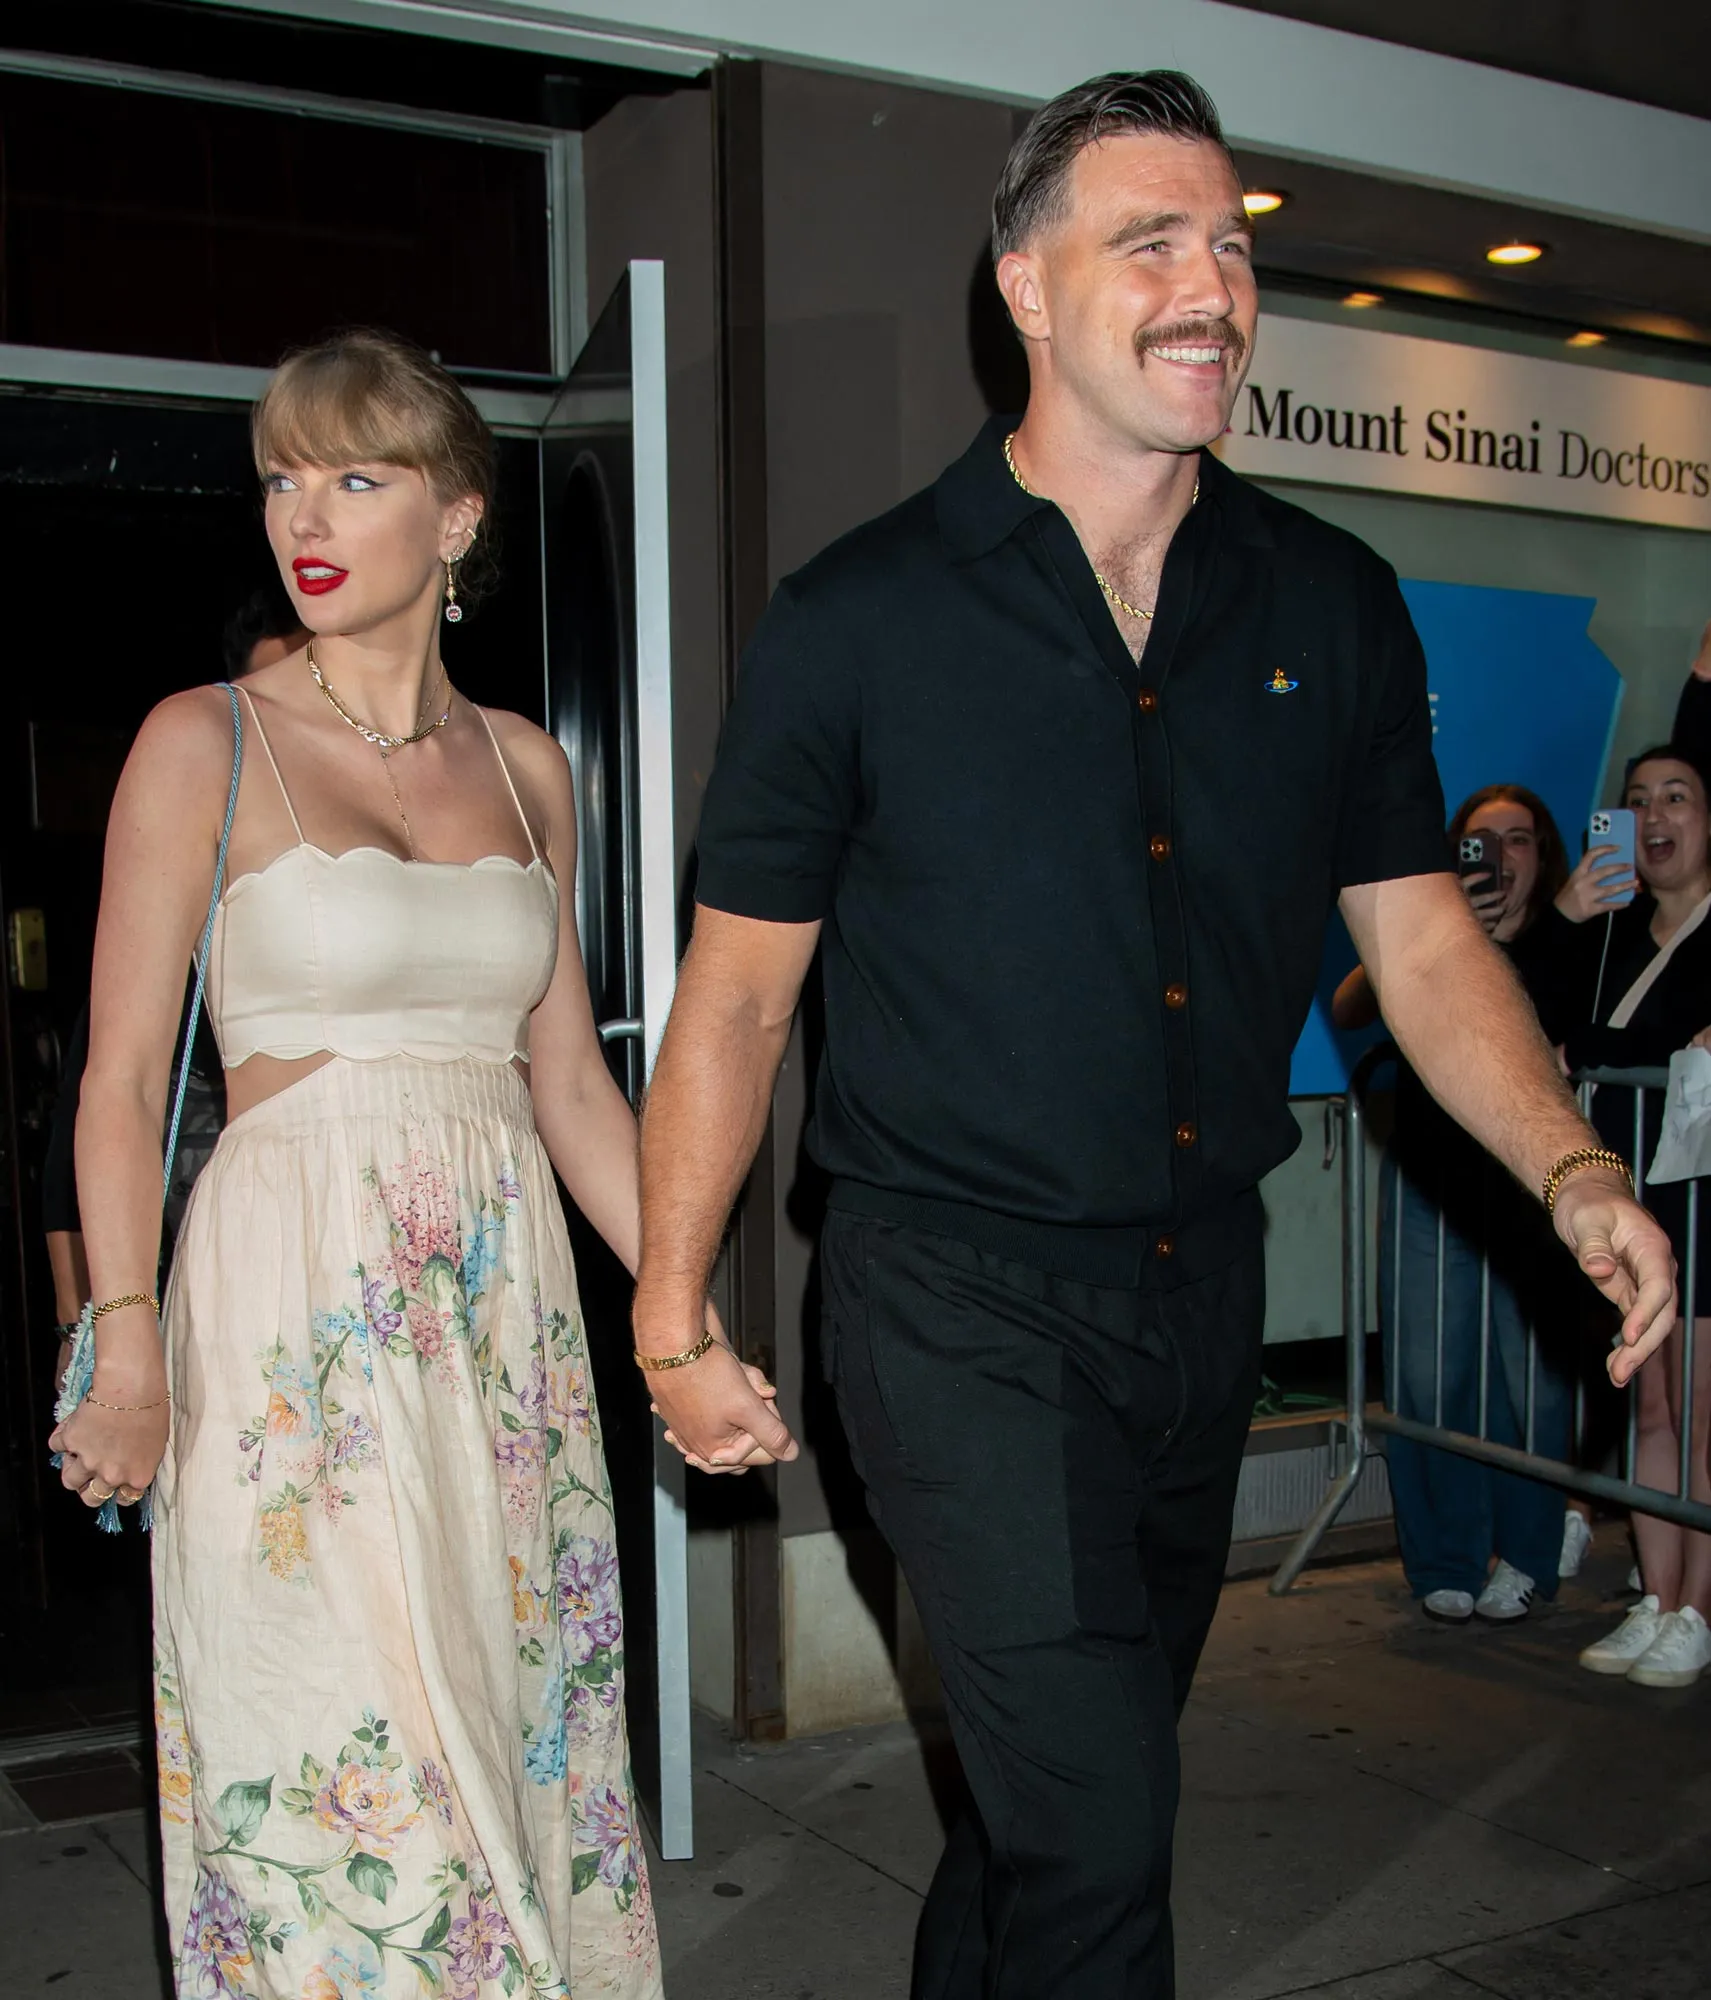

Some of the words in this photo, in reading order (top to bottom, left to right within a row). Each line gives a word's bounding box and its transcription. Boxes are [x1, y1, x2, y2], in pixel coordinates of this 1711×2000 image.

[1244, 384, 1408, 456] Mount
[1425, 409, 1542, 474] Sinai
[1557, 430, 1710, 498] Doctors
